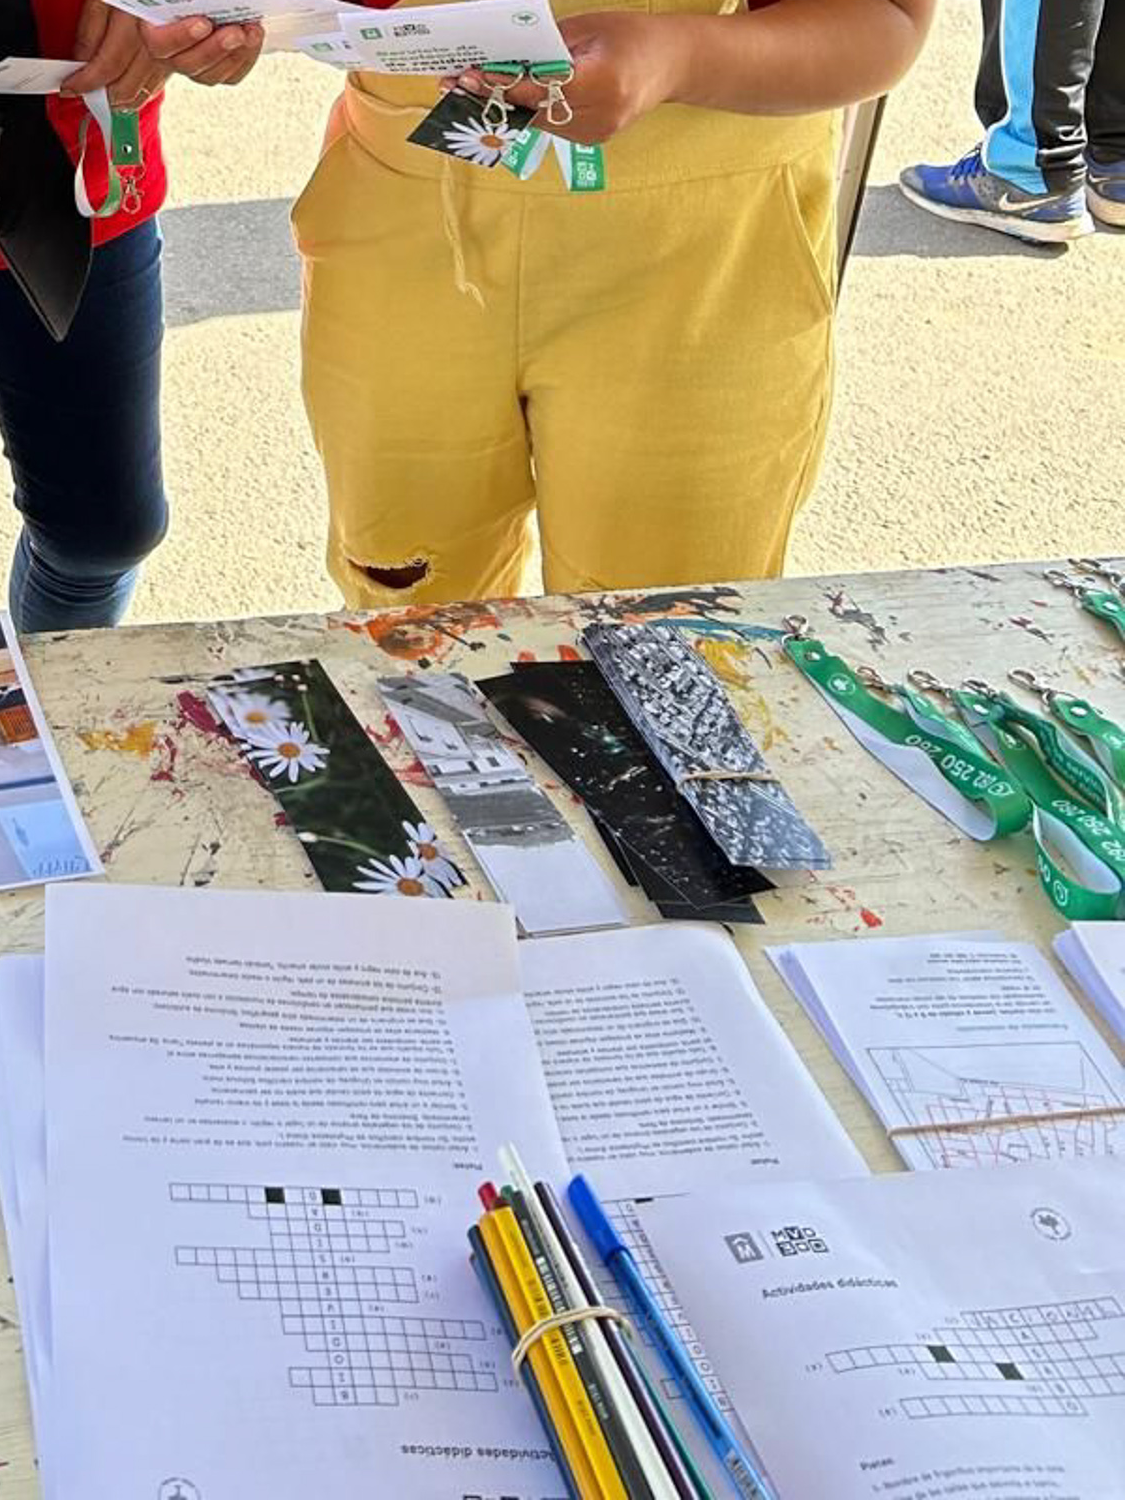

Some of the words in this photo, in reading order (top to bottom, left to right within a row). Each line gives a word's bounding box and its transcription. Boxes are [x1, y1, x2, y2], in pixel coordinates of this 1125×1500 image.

[940, 753, 972, 781] 250
[762, 1279, 835, 1300] Actividades
[837, 1275, 899, 1290] didácticas
[399, 1443, 472, 1459] didácticas
